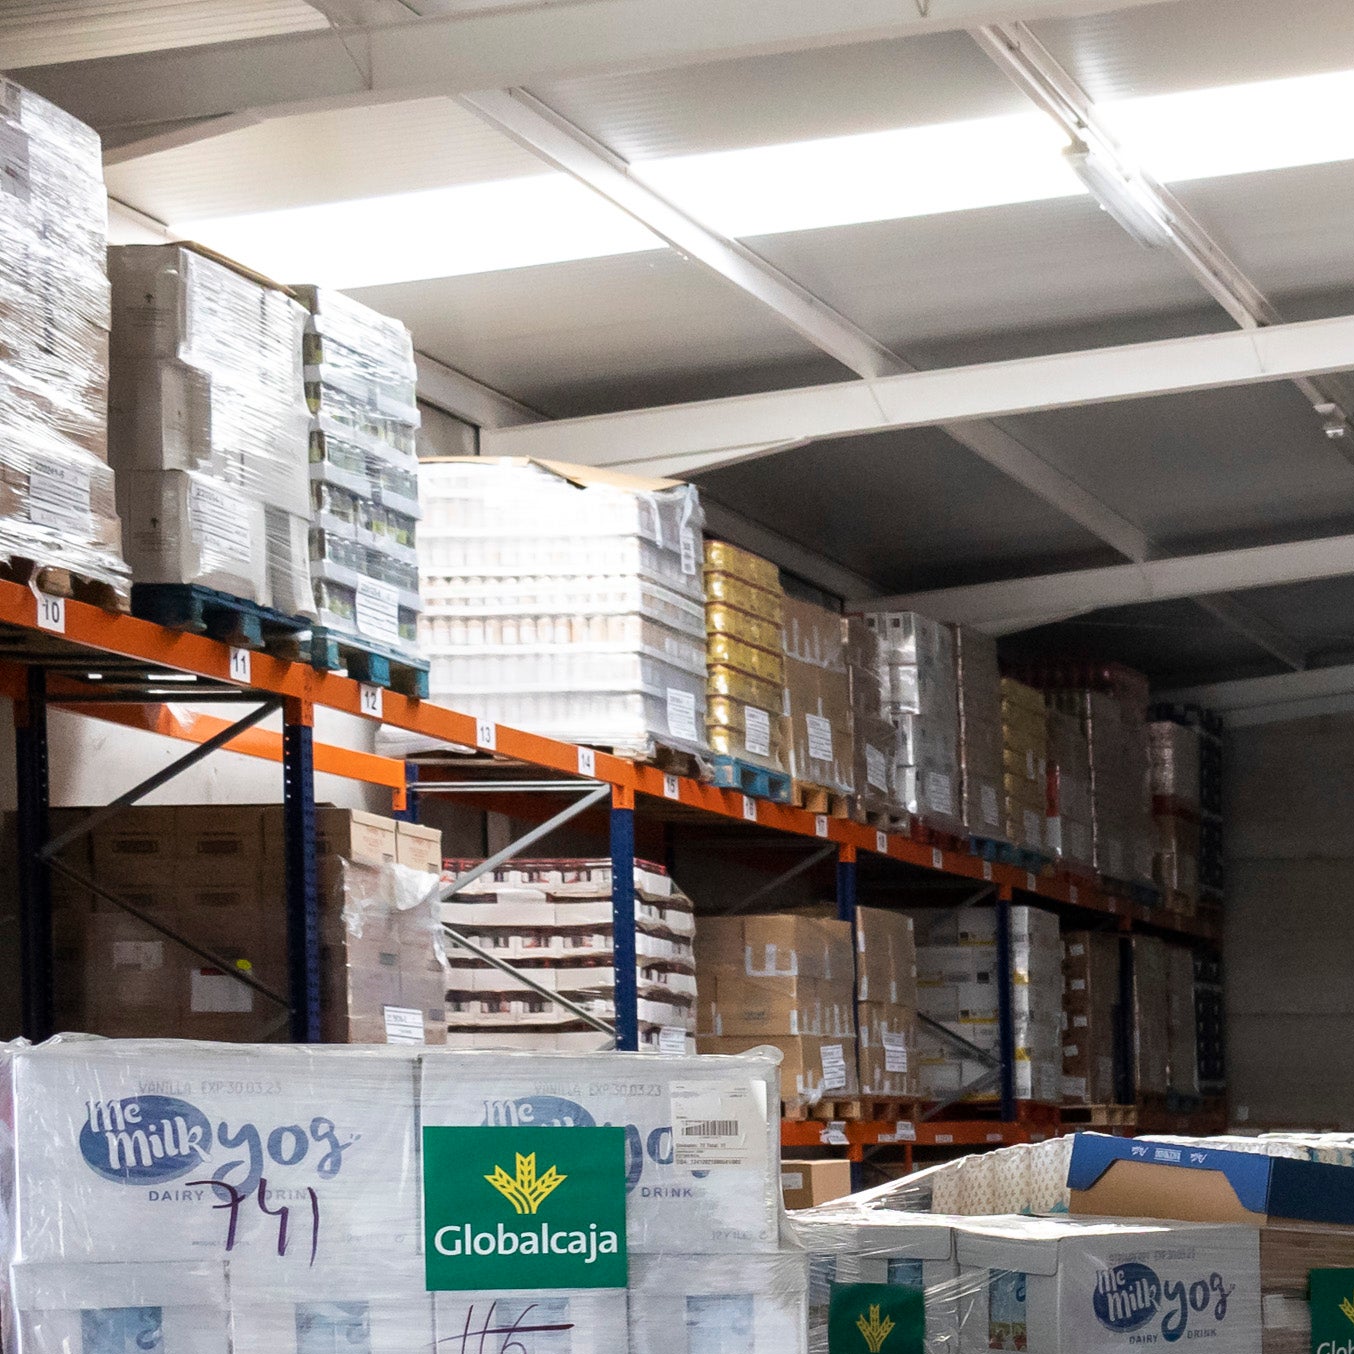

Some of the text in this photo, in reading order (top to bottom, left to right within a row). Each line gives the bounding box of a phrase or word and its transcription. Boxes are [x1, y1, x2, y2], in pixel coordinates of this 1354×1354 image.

[42, 600, 60, 624] 10
[233, 652, 248, 675] 11
[364, 691, 378, 711] 12
[480, 726, 491, 744] 13
[581, 752, 592, 769] 14
[212, 1116, 355, 1203] yog
[148, 1190, 205, 1202] DAIRY
[641, 1187, 694, 1198] DRINK
[434, 1223, 618, 1264] Globalcaja
[1161, 1272, 1234, 1342] yog
[1129, 1334, 1158, 1345] DAIRY
